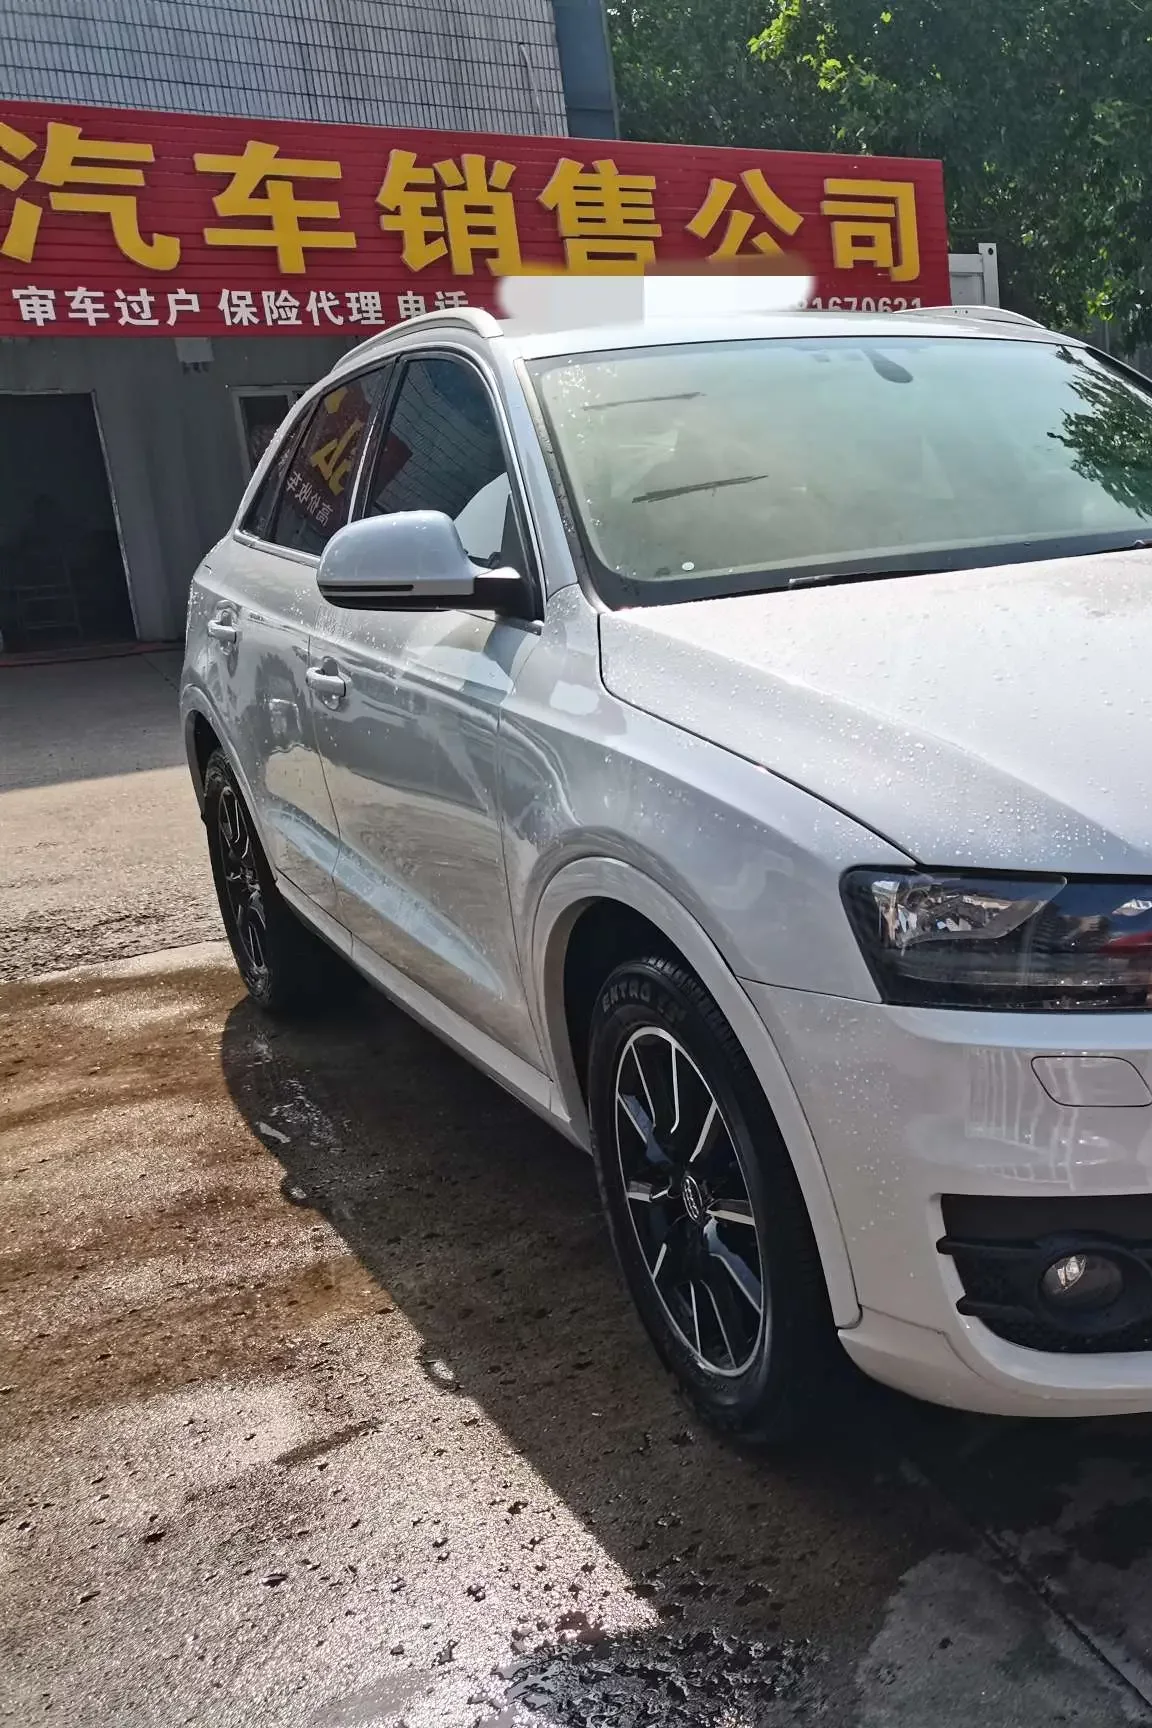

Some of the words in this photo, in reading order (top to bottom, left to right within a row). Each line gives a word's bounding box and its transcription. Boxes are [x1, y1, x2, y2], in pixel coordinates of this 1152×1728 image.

[0, 121, 921, 283] 汽车销售公司
[12, 286, 201, 327] 审车过户
[217, 288, 386, 327] 保险代理
